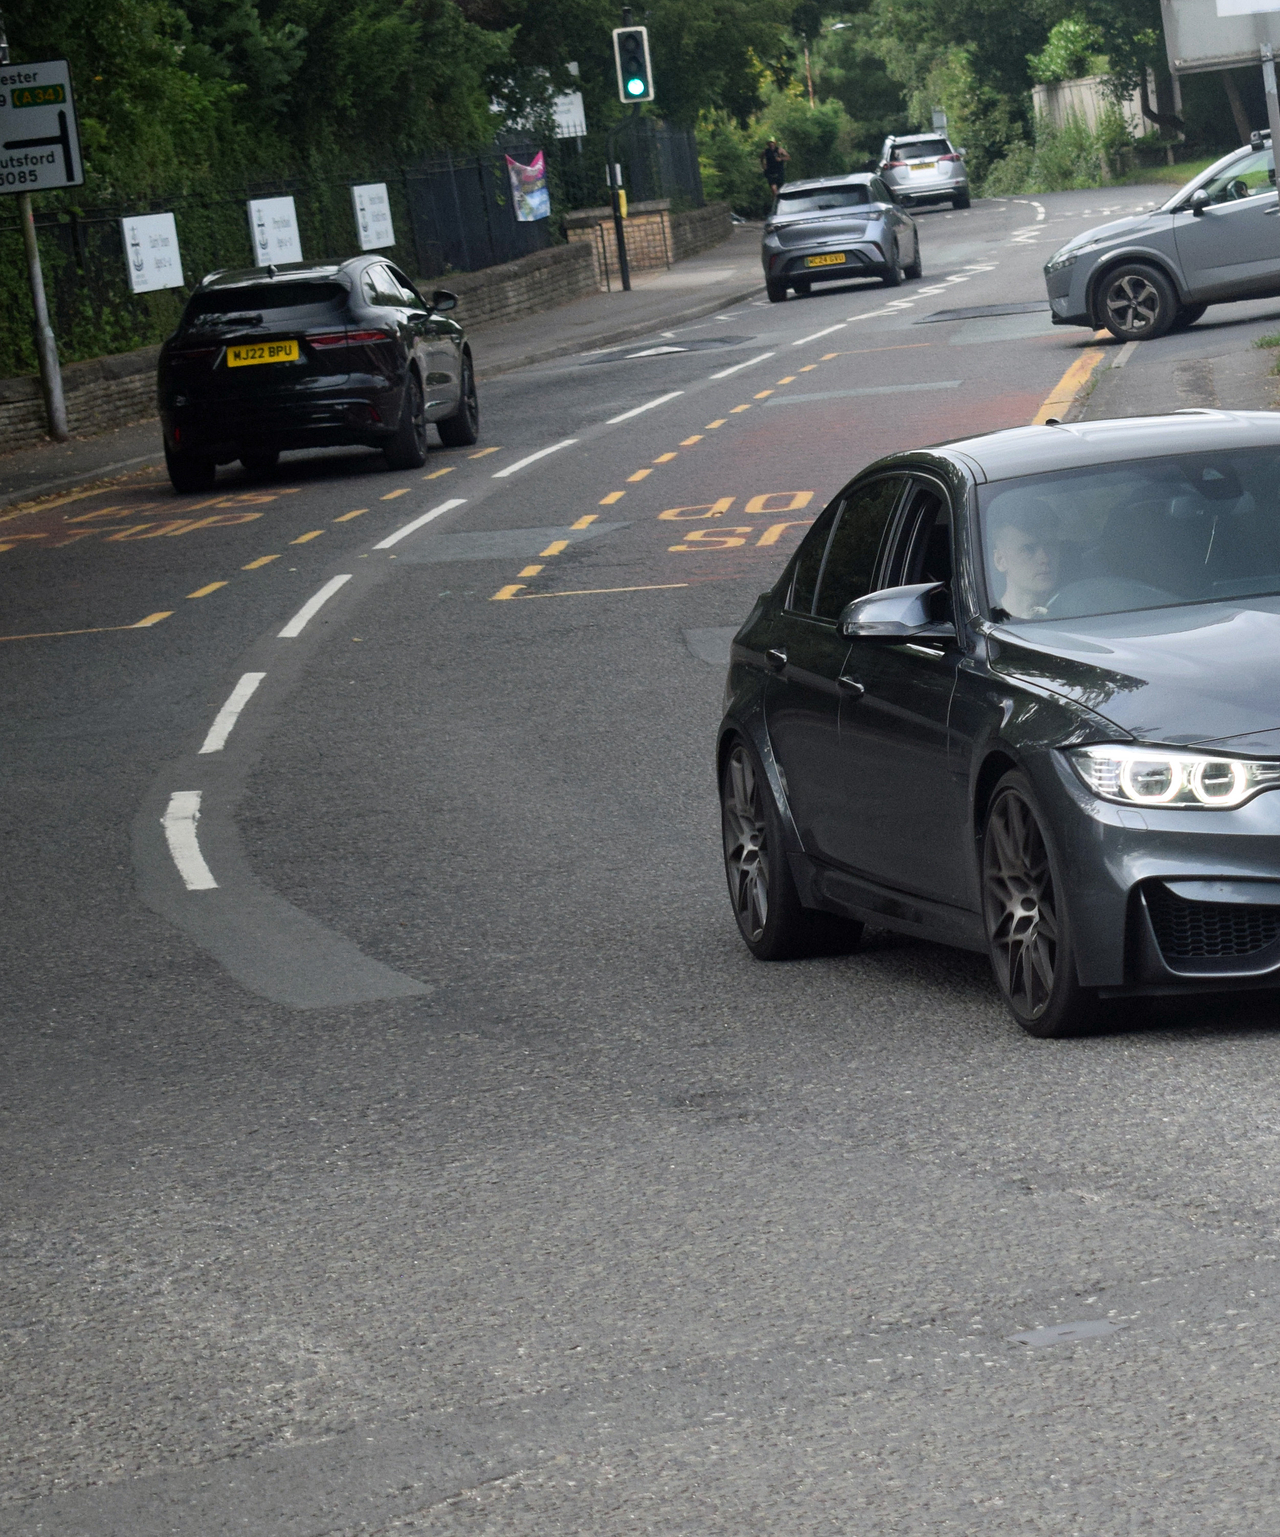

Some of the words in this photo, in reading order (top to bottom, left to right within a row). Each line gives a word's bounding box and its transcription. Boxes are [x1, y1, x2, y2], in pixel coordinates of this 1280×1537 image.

[13, 86, 64, 106] (A34)
[0, 151, 55, 168] utsford
[233, 347, 265, 361] MJ22
[268, 344, 292, 357] BPU
